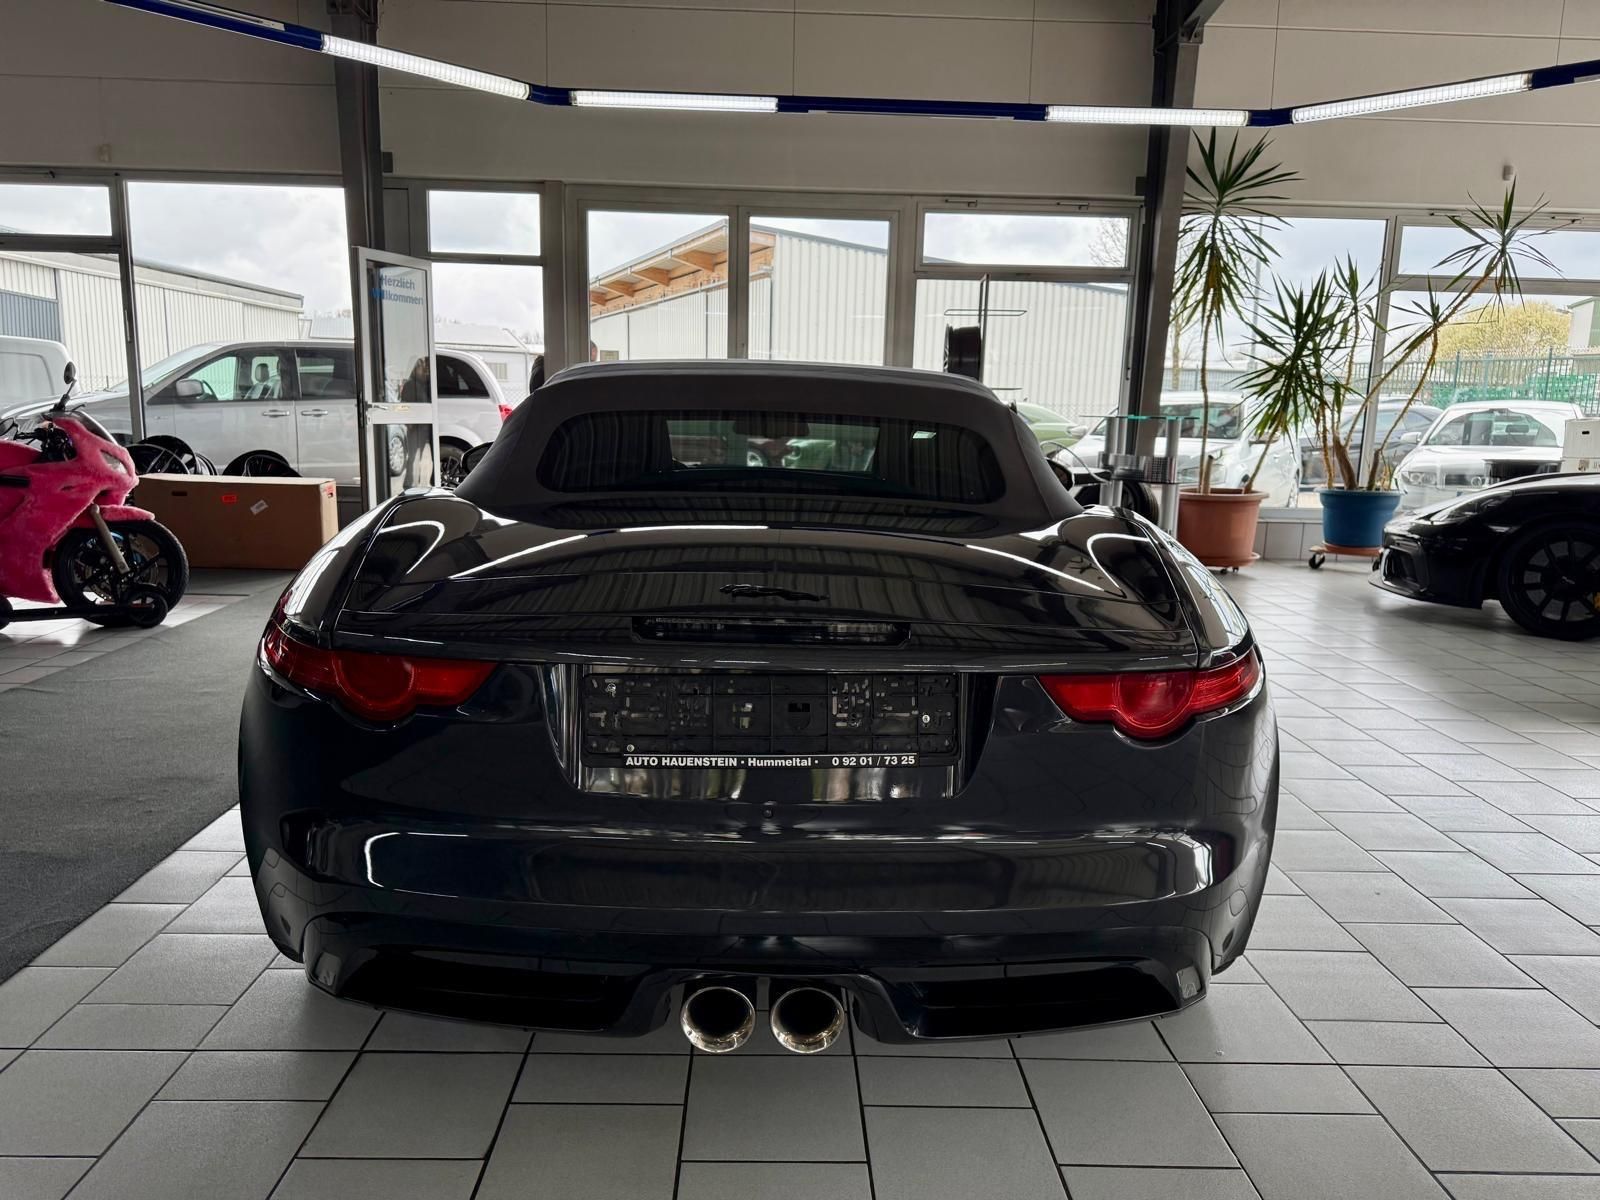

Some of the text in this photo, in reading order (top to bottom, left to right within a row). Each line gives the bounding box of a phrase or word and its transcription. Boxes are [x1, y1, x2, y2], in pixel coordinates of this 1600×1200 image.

[380, 274, 415, 290] Herzlich
[625, 757, 658, 767] AUTO
[662, 757, 737, 767] HAUENSTEIN
[748, 757, 812, 767] Hummeltal
[832, 757, 839, 766] 0
[842, 757, 857, 766] 92
[860, 756, 873, 766] 01
[884, 756, 898, 765] 73
[901, 756, 915, 765] 25
